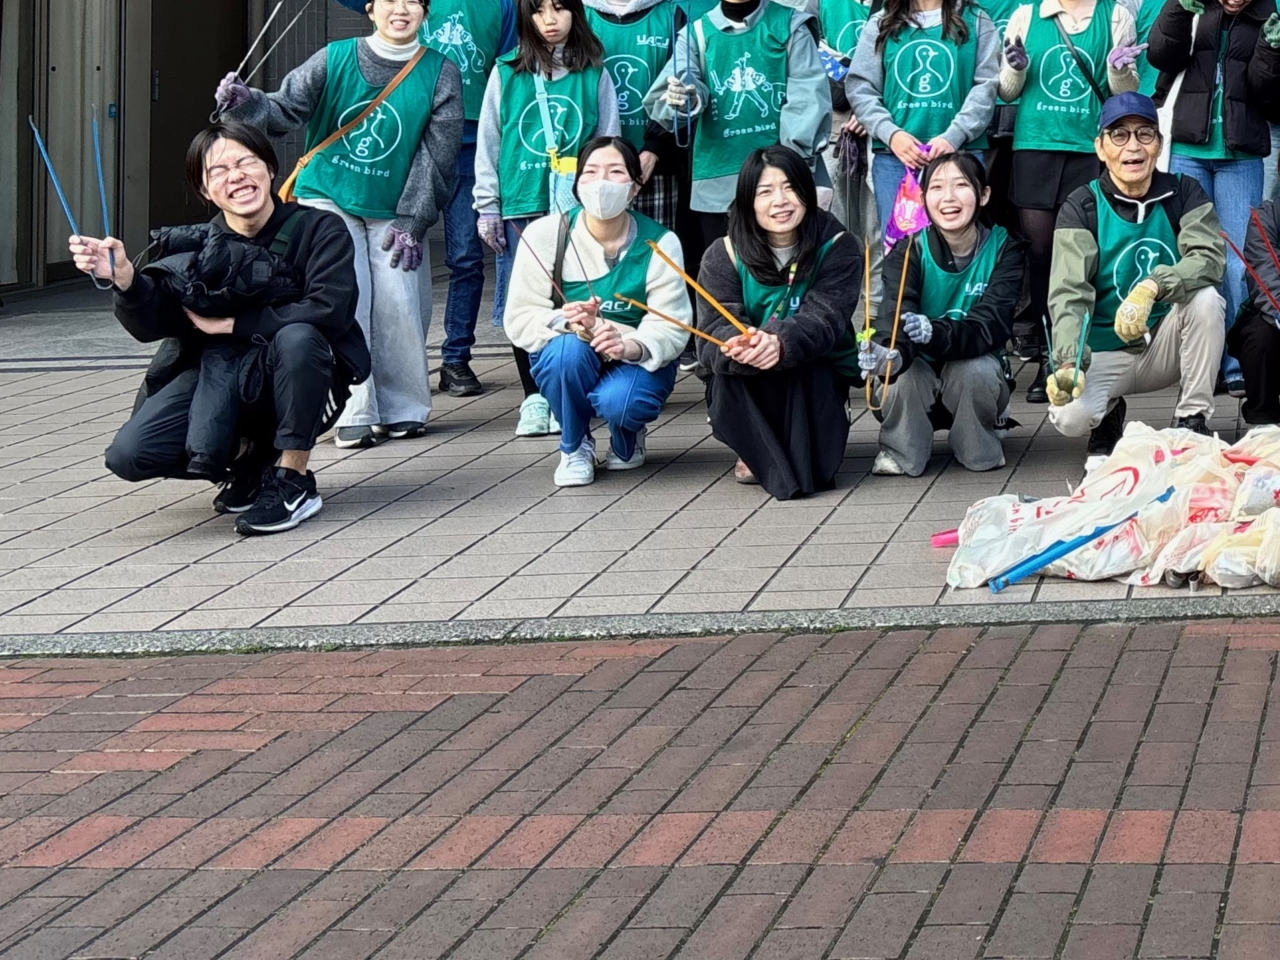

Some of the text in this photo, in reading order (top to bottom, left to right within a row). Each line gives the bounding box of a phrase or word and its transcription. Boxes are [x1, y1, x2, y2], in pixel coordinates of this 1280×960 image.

[636, 34, 669, 49] UACJ
[896, 100, 953, 109] green bird
[1036, 101, 1067, 112] green
[331, 155, 390, 177] green bird
[599, 300, 632, 312] ACJ
